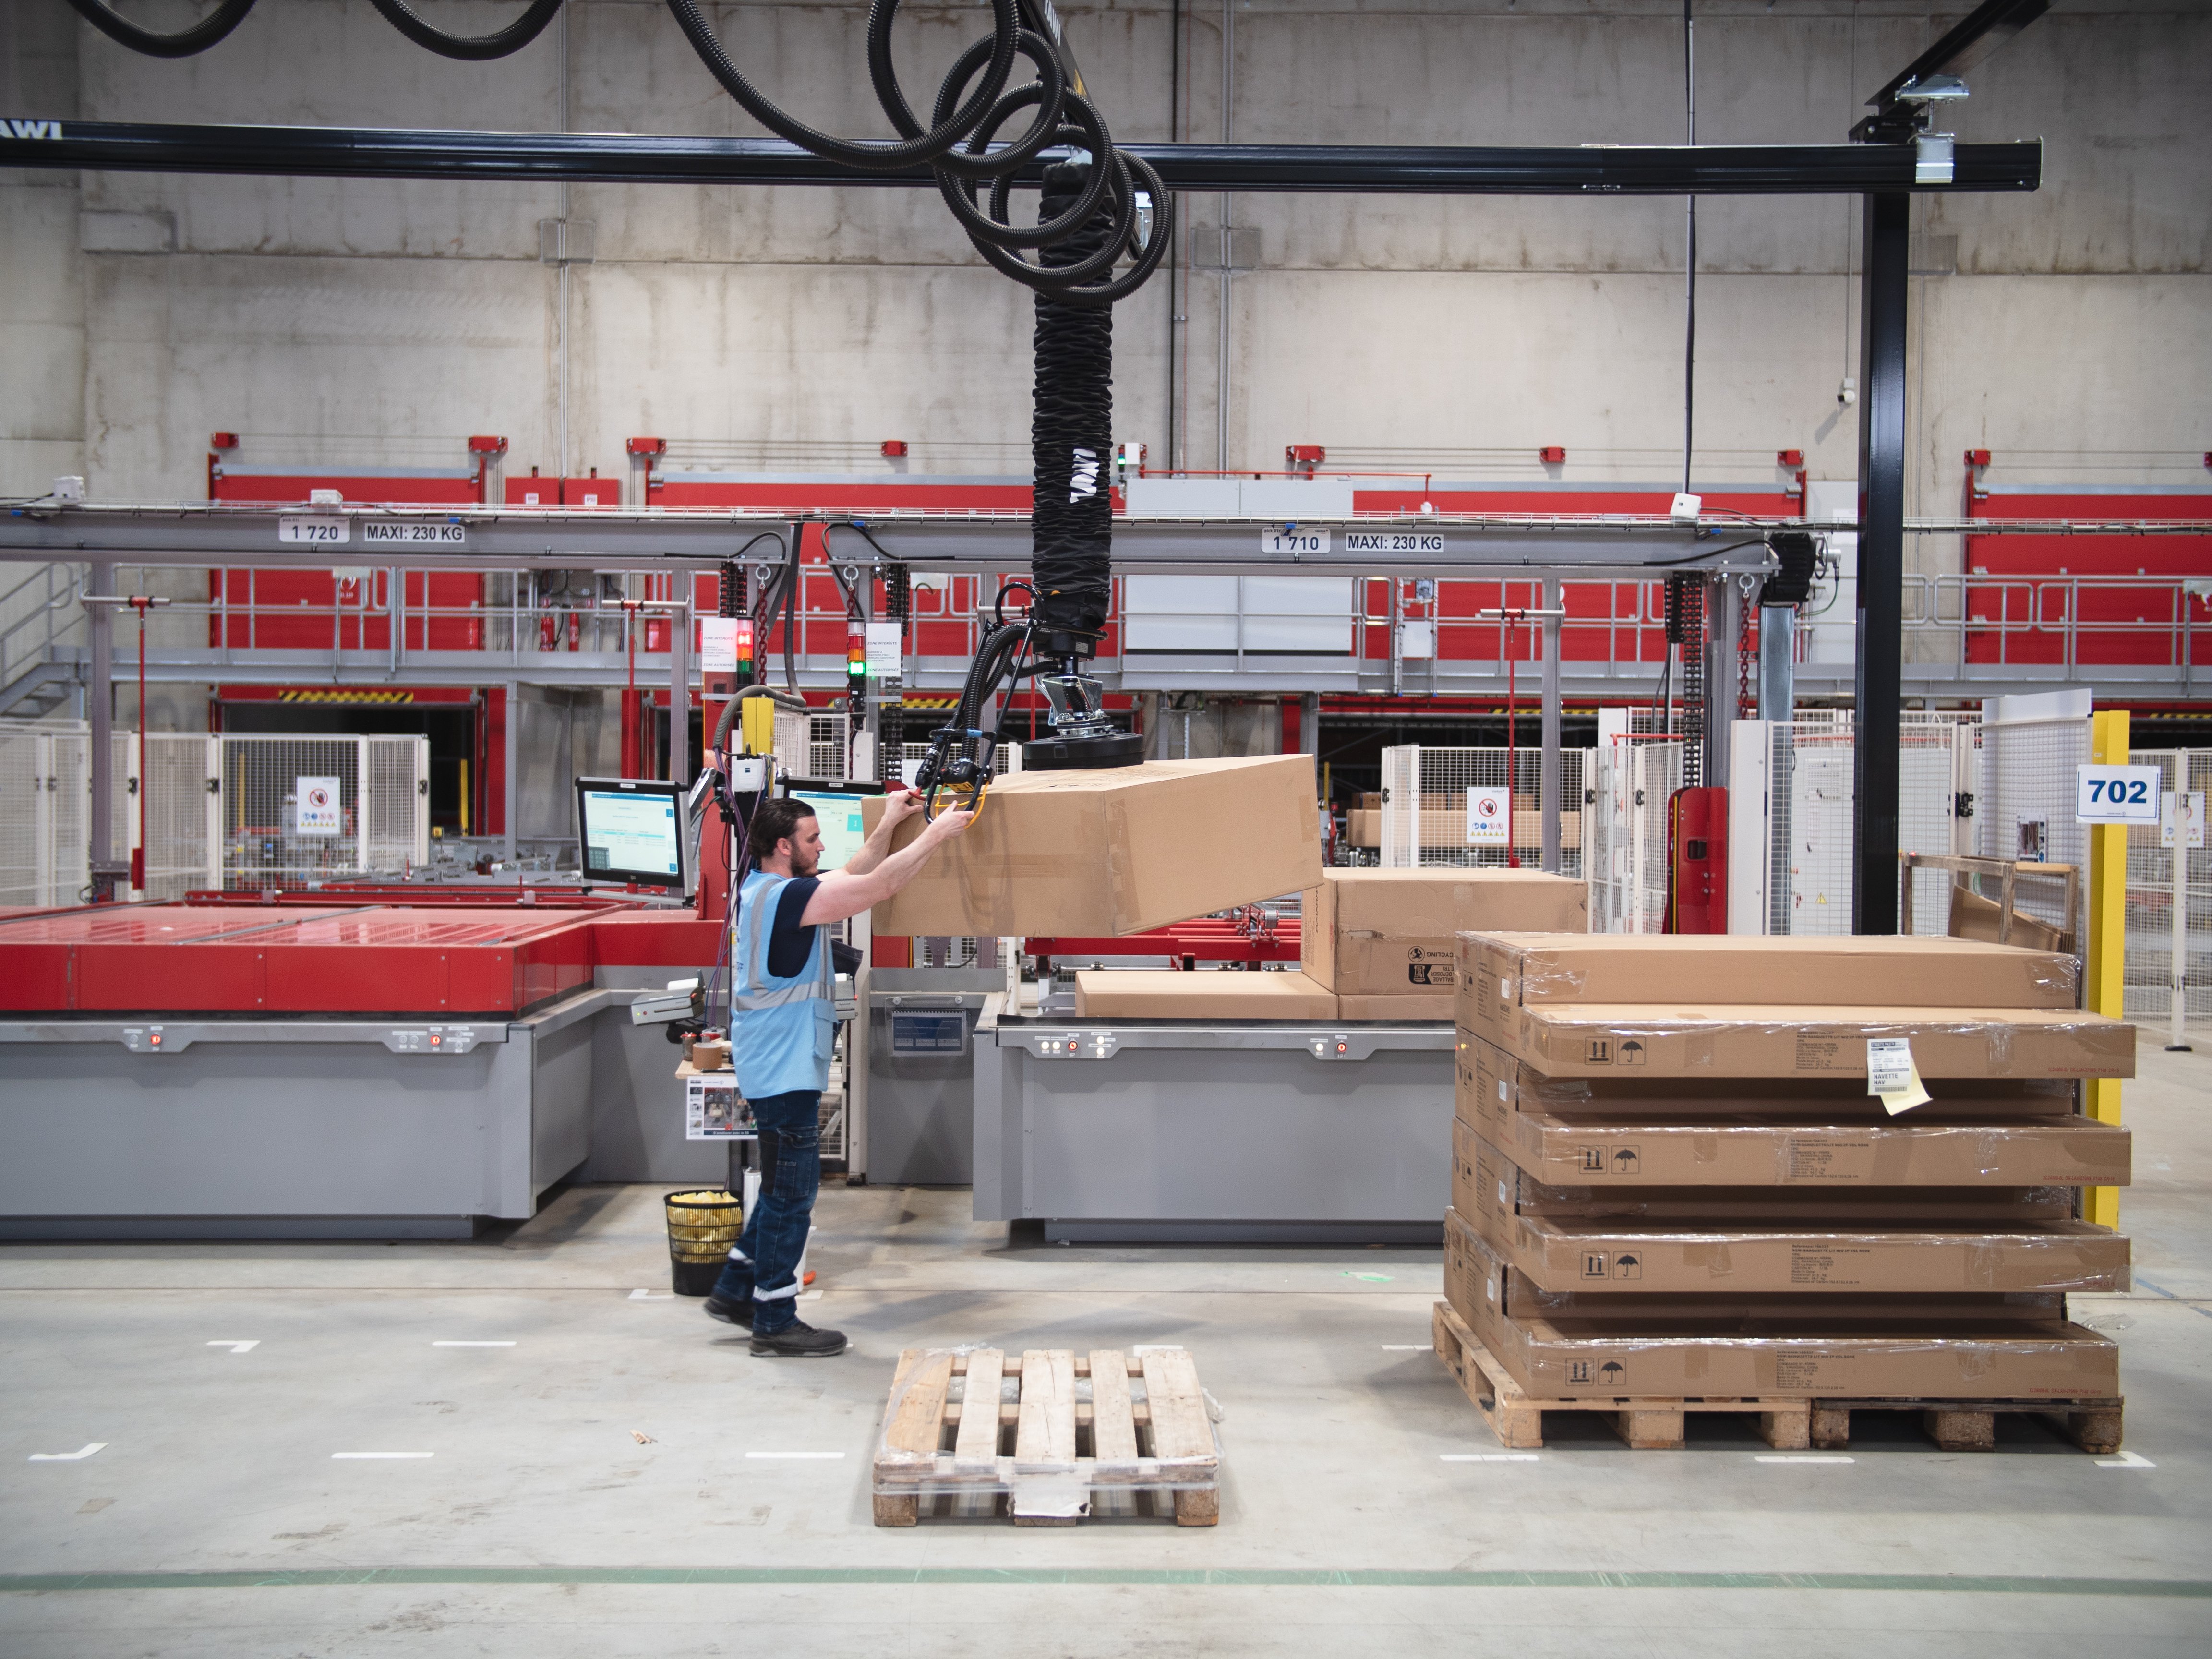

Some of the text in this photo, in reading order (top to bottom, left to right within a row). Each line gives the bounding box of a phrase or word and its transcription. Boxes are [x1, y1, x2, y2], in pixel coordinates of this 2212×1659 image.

[292, 525, 338, 540] 1 720
[367, 525, 463, 541] MAXI: 230 KG
[1274, 536, 1319, 550] 1 710
[1347, 535, 1442, 550] MAXI: 230 KG
[2088, 780, 2147, 804] 702
